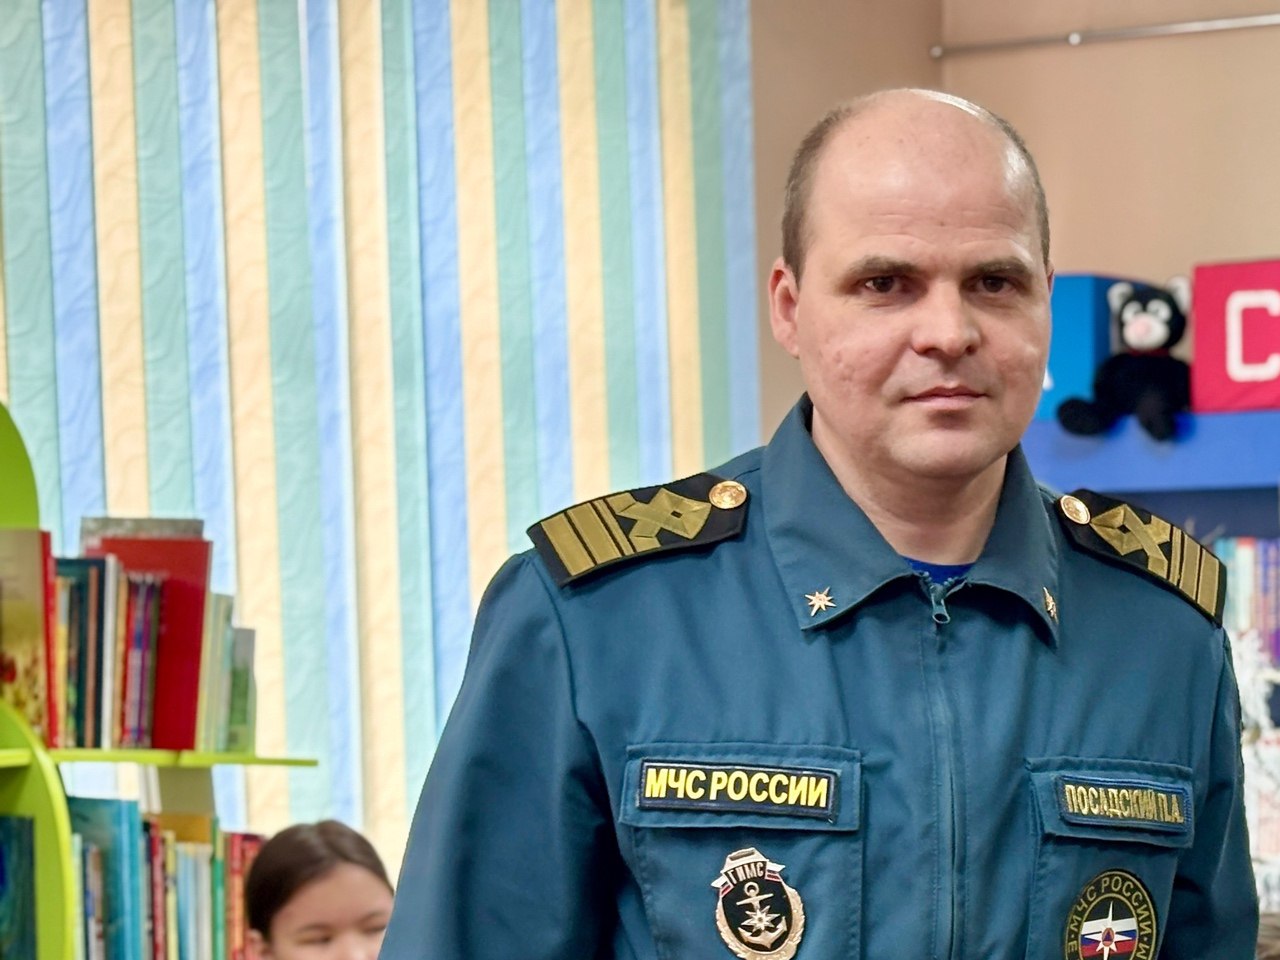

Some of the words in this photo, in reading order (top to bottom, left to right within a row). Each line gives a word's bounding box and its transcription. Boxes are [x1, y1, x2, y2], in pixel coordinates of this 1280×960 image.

[645, 768, 706, 800] МЧС
[709, 771, 829, 808] РОССИИ
[1068, 885, 1097, 935] МЧС
[1101, 876, 1153, 934] РОССИИ
